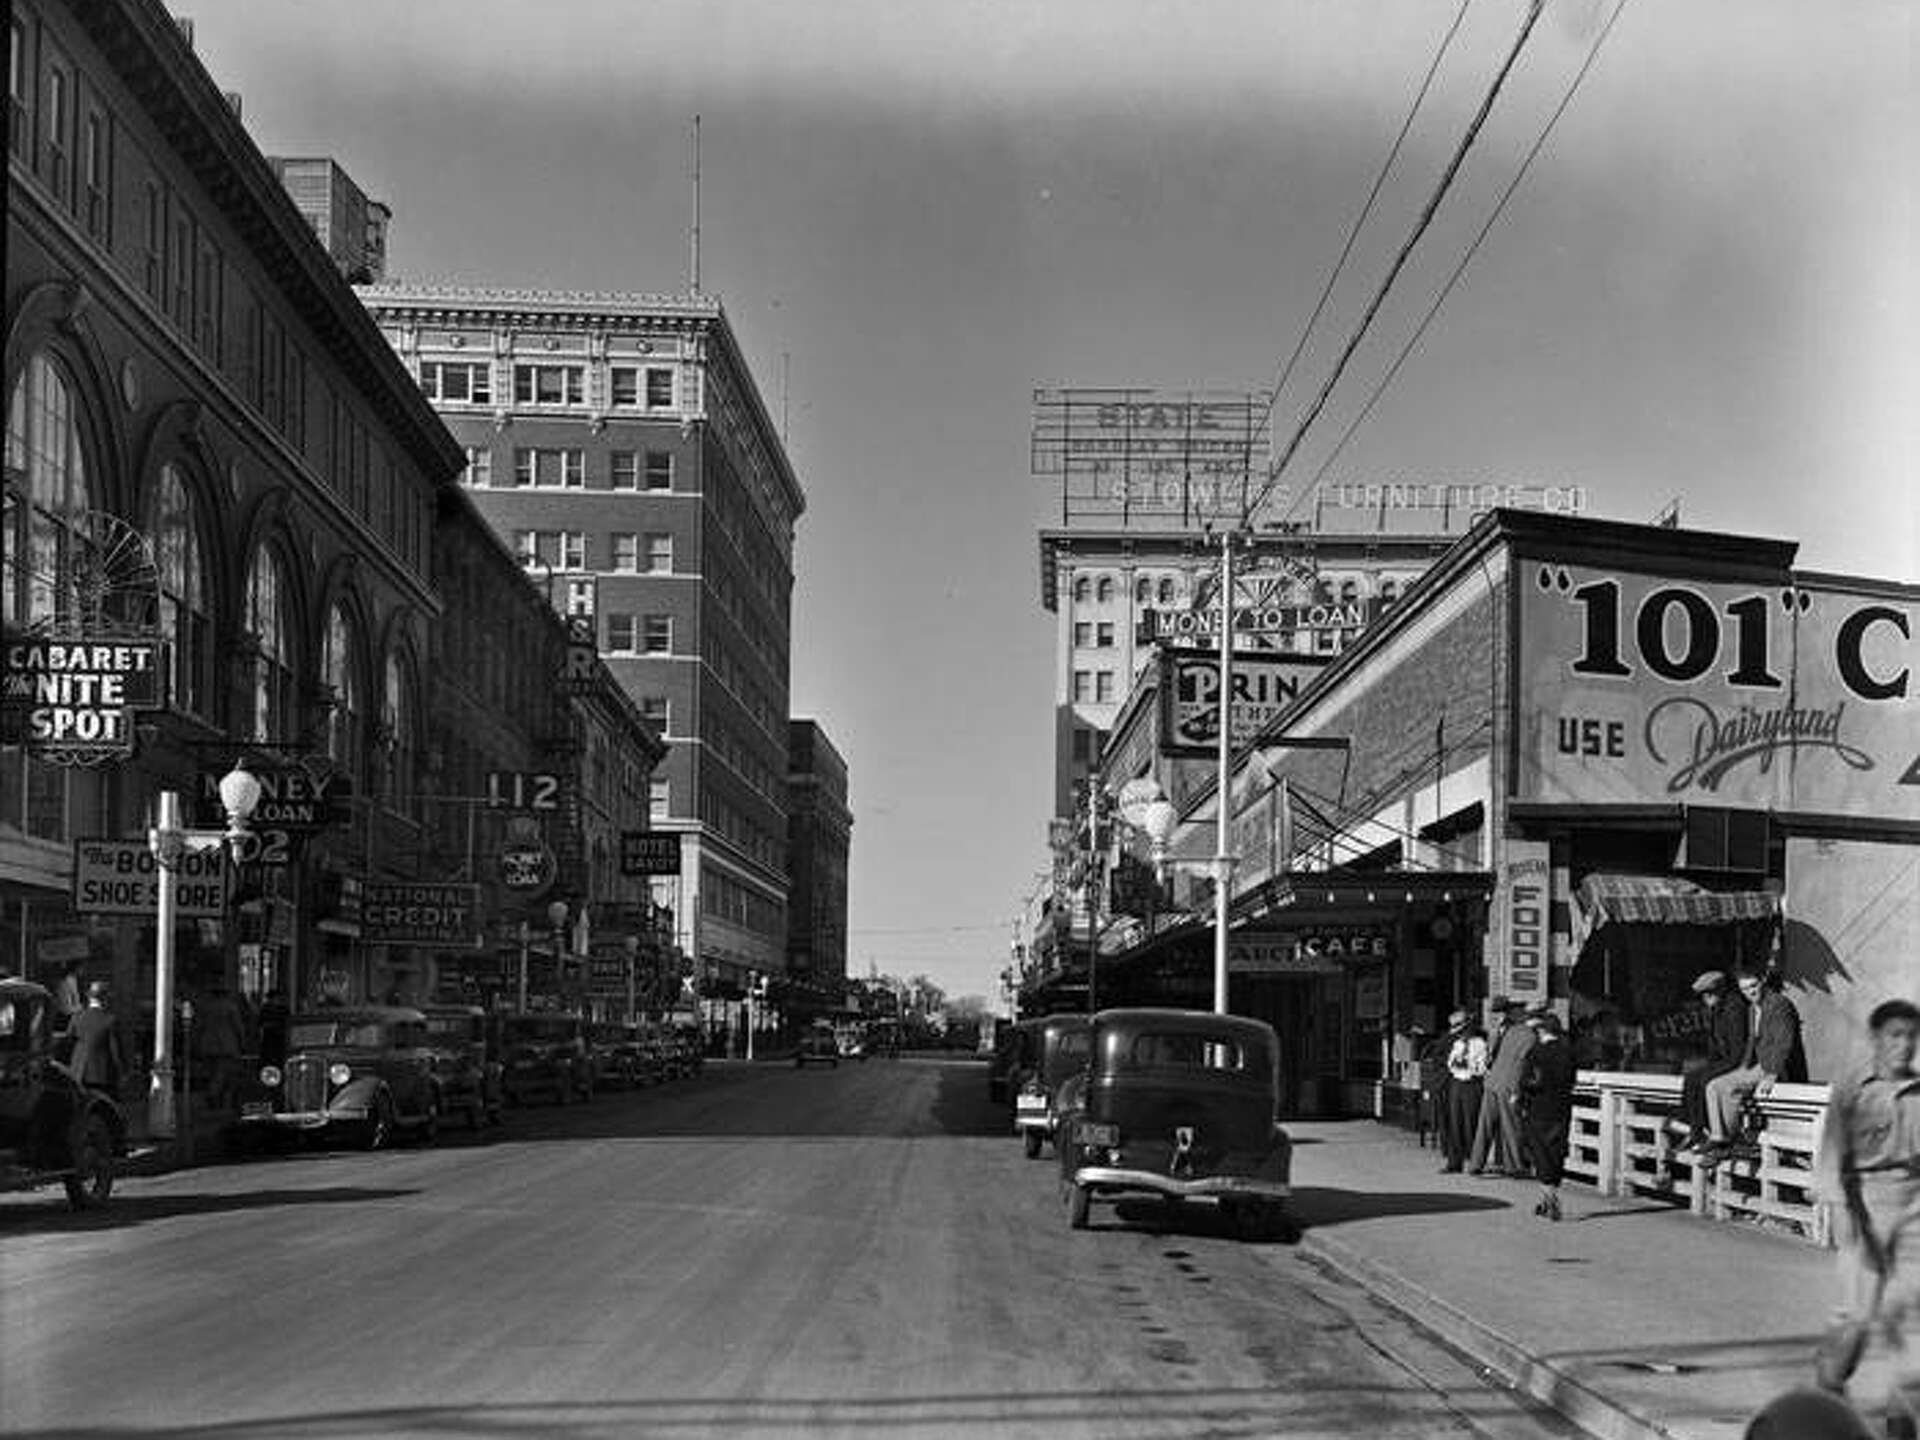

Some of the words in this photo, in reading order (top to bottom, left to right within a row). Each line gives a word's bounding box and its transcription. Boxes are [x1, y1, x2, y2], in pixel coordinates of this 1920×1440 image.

[1247, 609, 1281, 630] TO
[1292, 604, 1362, 630] LOAN
[9, 646, 150, 671] CABARET
[36, 674, 124, 704] NITE
[31, 708, 121, 740] SPOT
[1558, 718, 1624, 757] USE
[1645, 698, 1873, 793] Dairyland
[203, 771, 332, 802] MNEY
[489, 773, 558, 808] 112
[248, 804, 314, 823] LOAN
[83, 881, 143, 905] SHOE
[149, 884, 219, 908] SORE
[364, 905, 468, 926] CREDIT
[1513, 885, 1540, 991] FOODS
